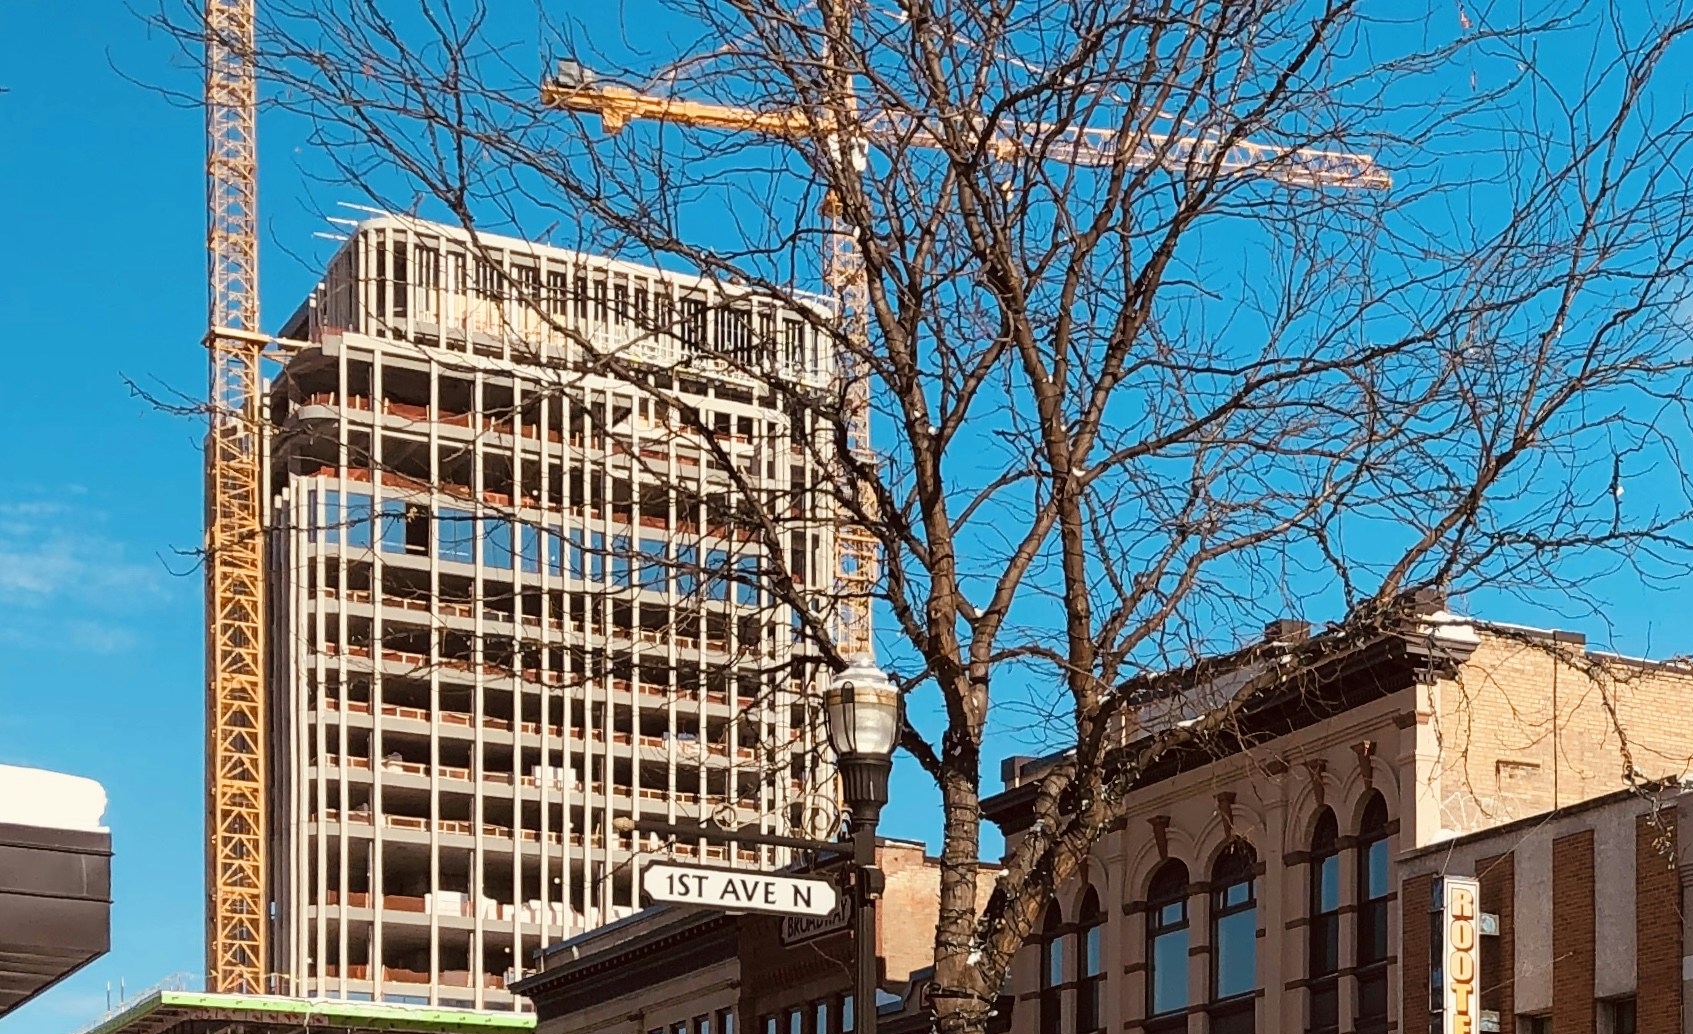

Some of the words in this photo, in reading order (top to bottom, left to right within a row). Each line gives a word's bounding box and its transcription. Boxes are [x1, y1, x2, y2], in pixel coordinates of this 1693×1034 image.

[666, 873, 709, 898] 1ST
[719, 878, 776, 904] AVE
[792, 884, 812, 908] N
